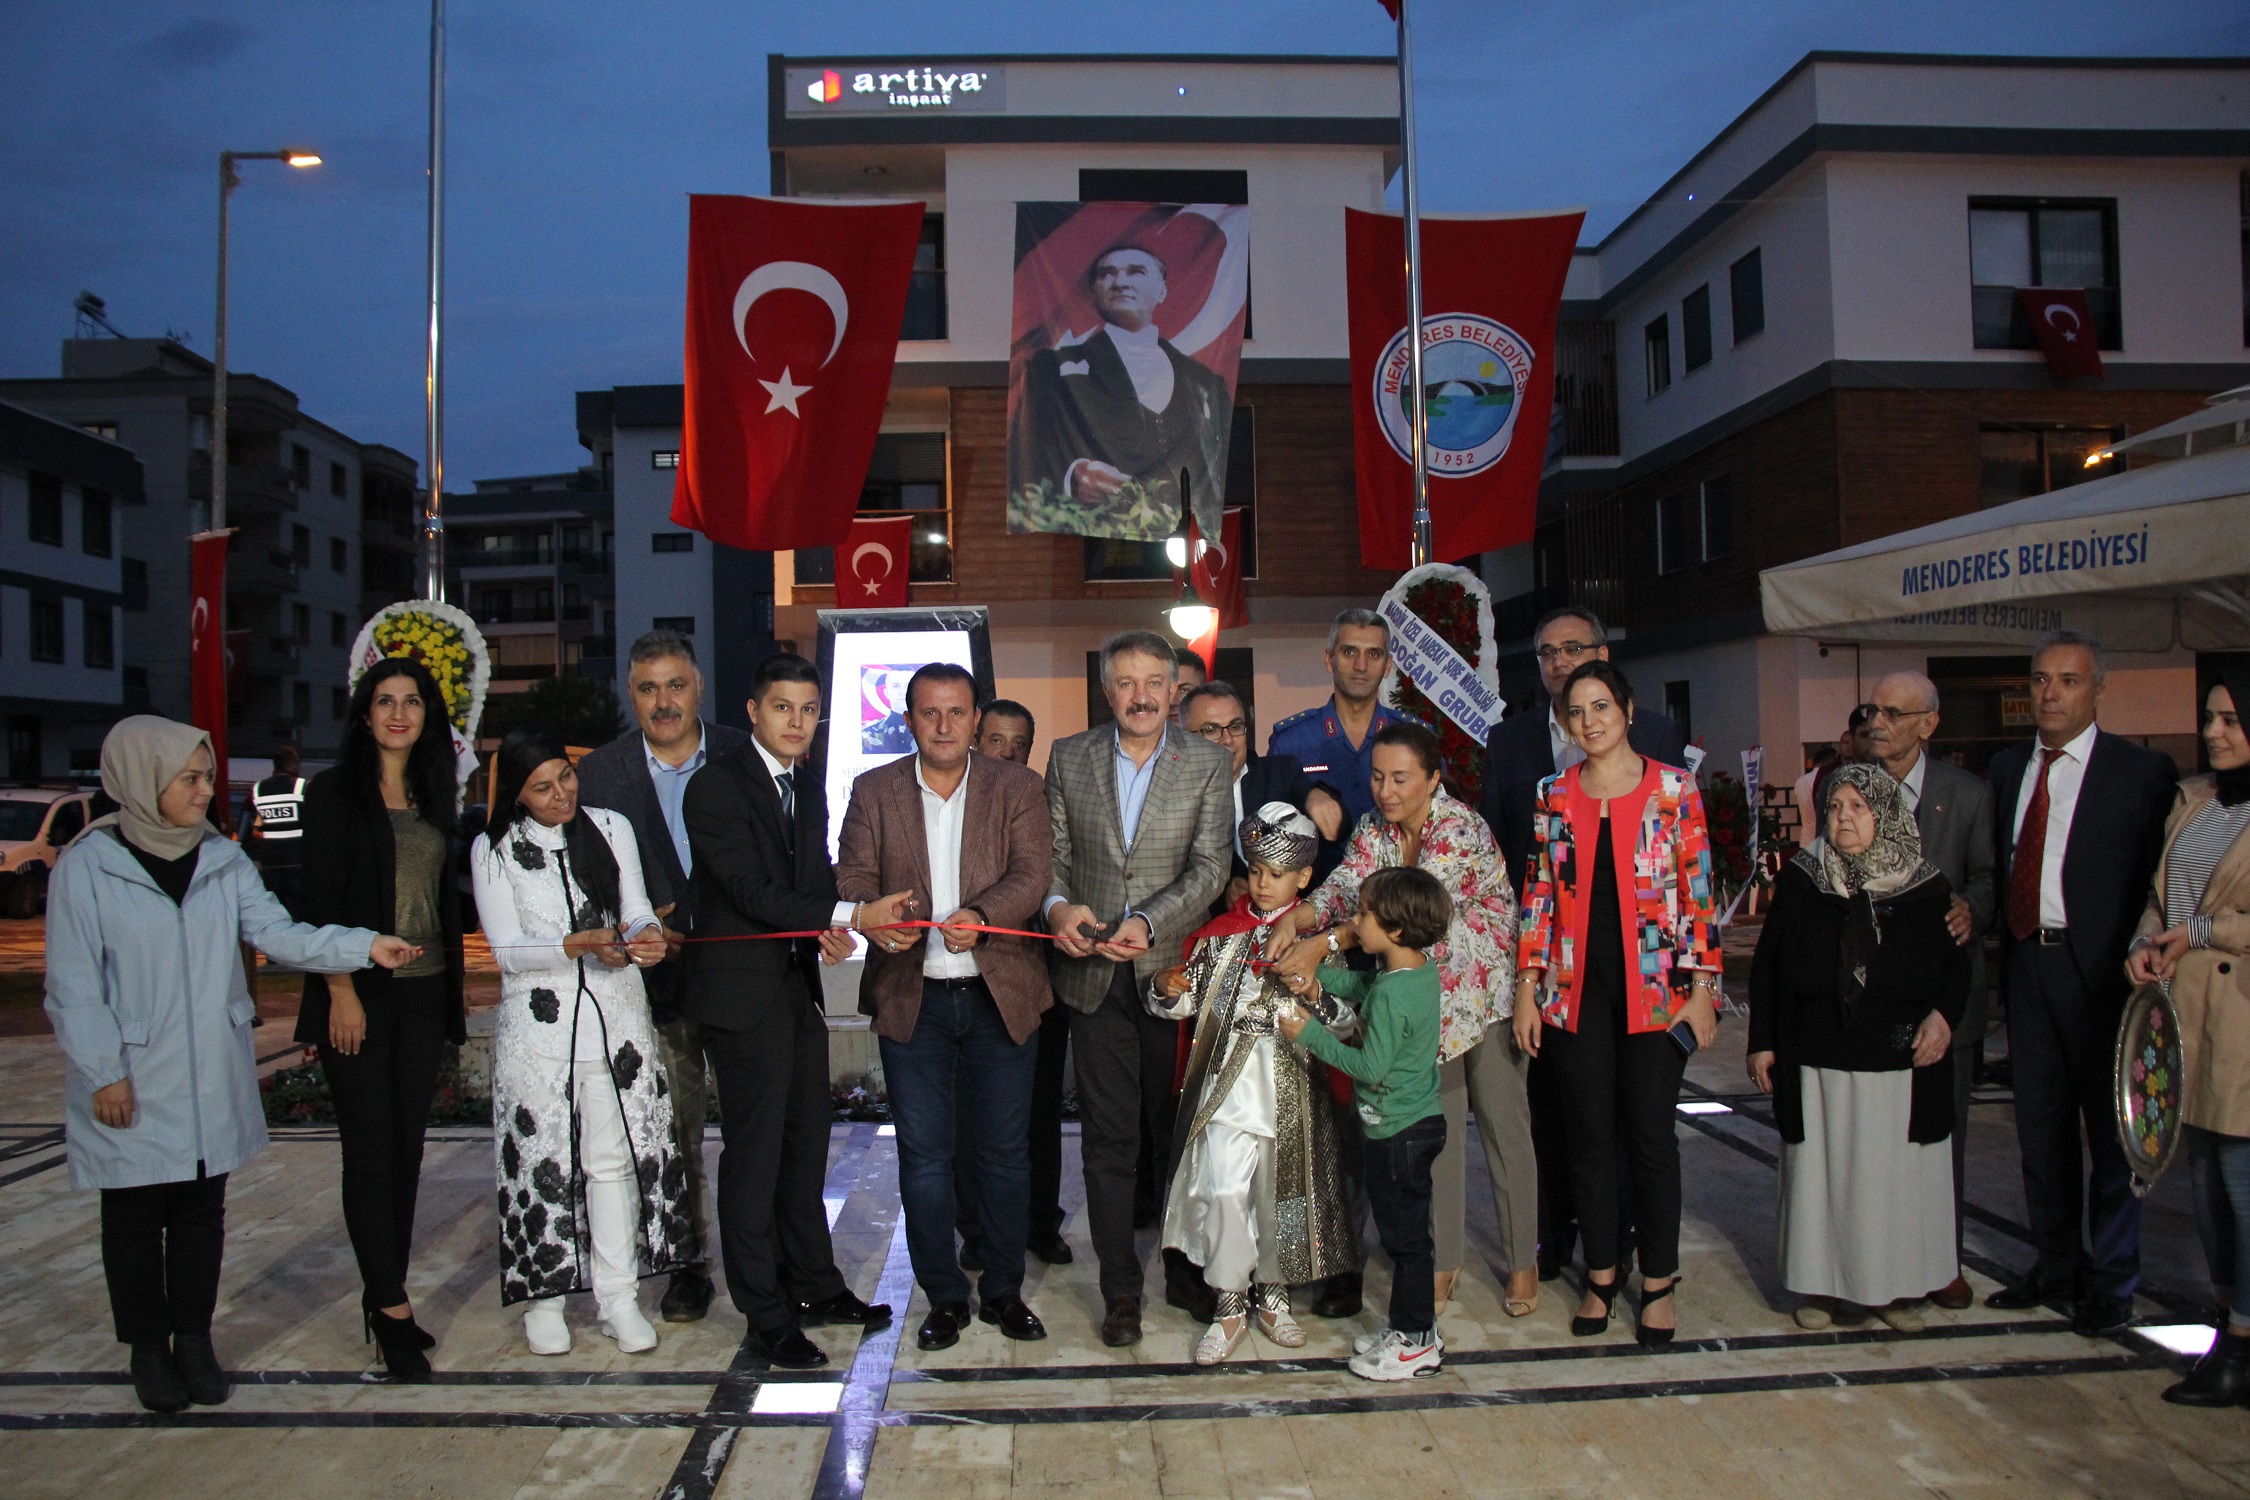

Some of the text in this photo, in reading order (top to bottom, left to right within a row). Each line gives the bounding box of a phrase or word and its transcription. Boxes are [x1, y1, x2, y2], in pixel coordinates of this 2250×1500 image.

[852, 67, 983, 94] artiya
[889, 92, 951, 107] inşaat
[1384, 325, 1454, 395] MENDRES
[1434, 451, 1474, 466] 1952
[1902, 523, 2148, 596] MENDERES BELEDİYESİ
[1390, 634, 1438, 692] DOĞAN
[1402, 617, 1423, 643] ÖZEL
[1416, 632, 1449, 667] HAREKAT
